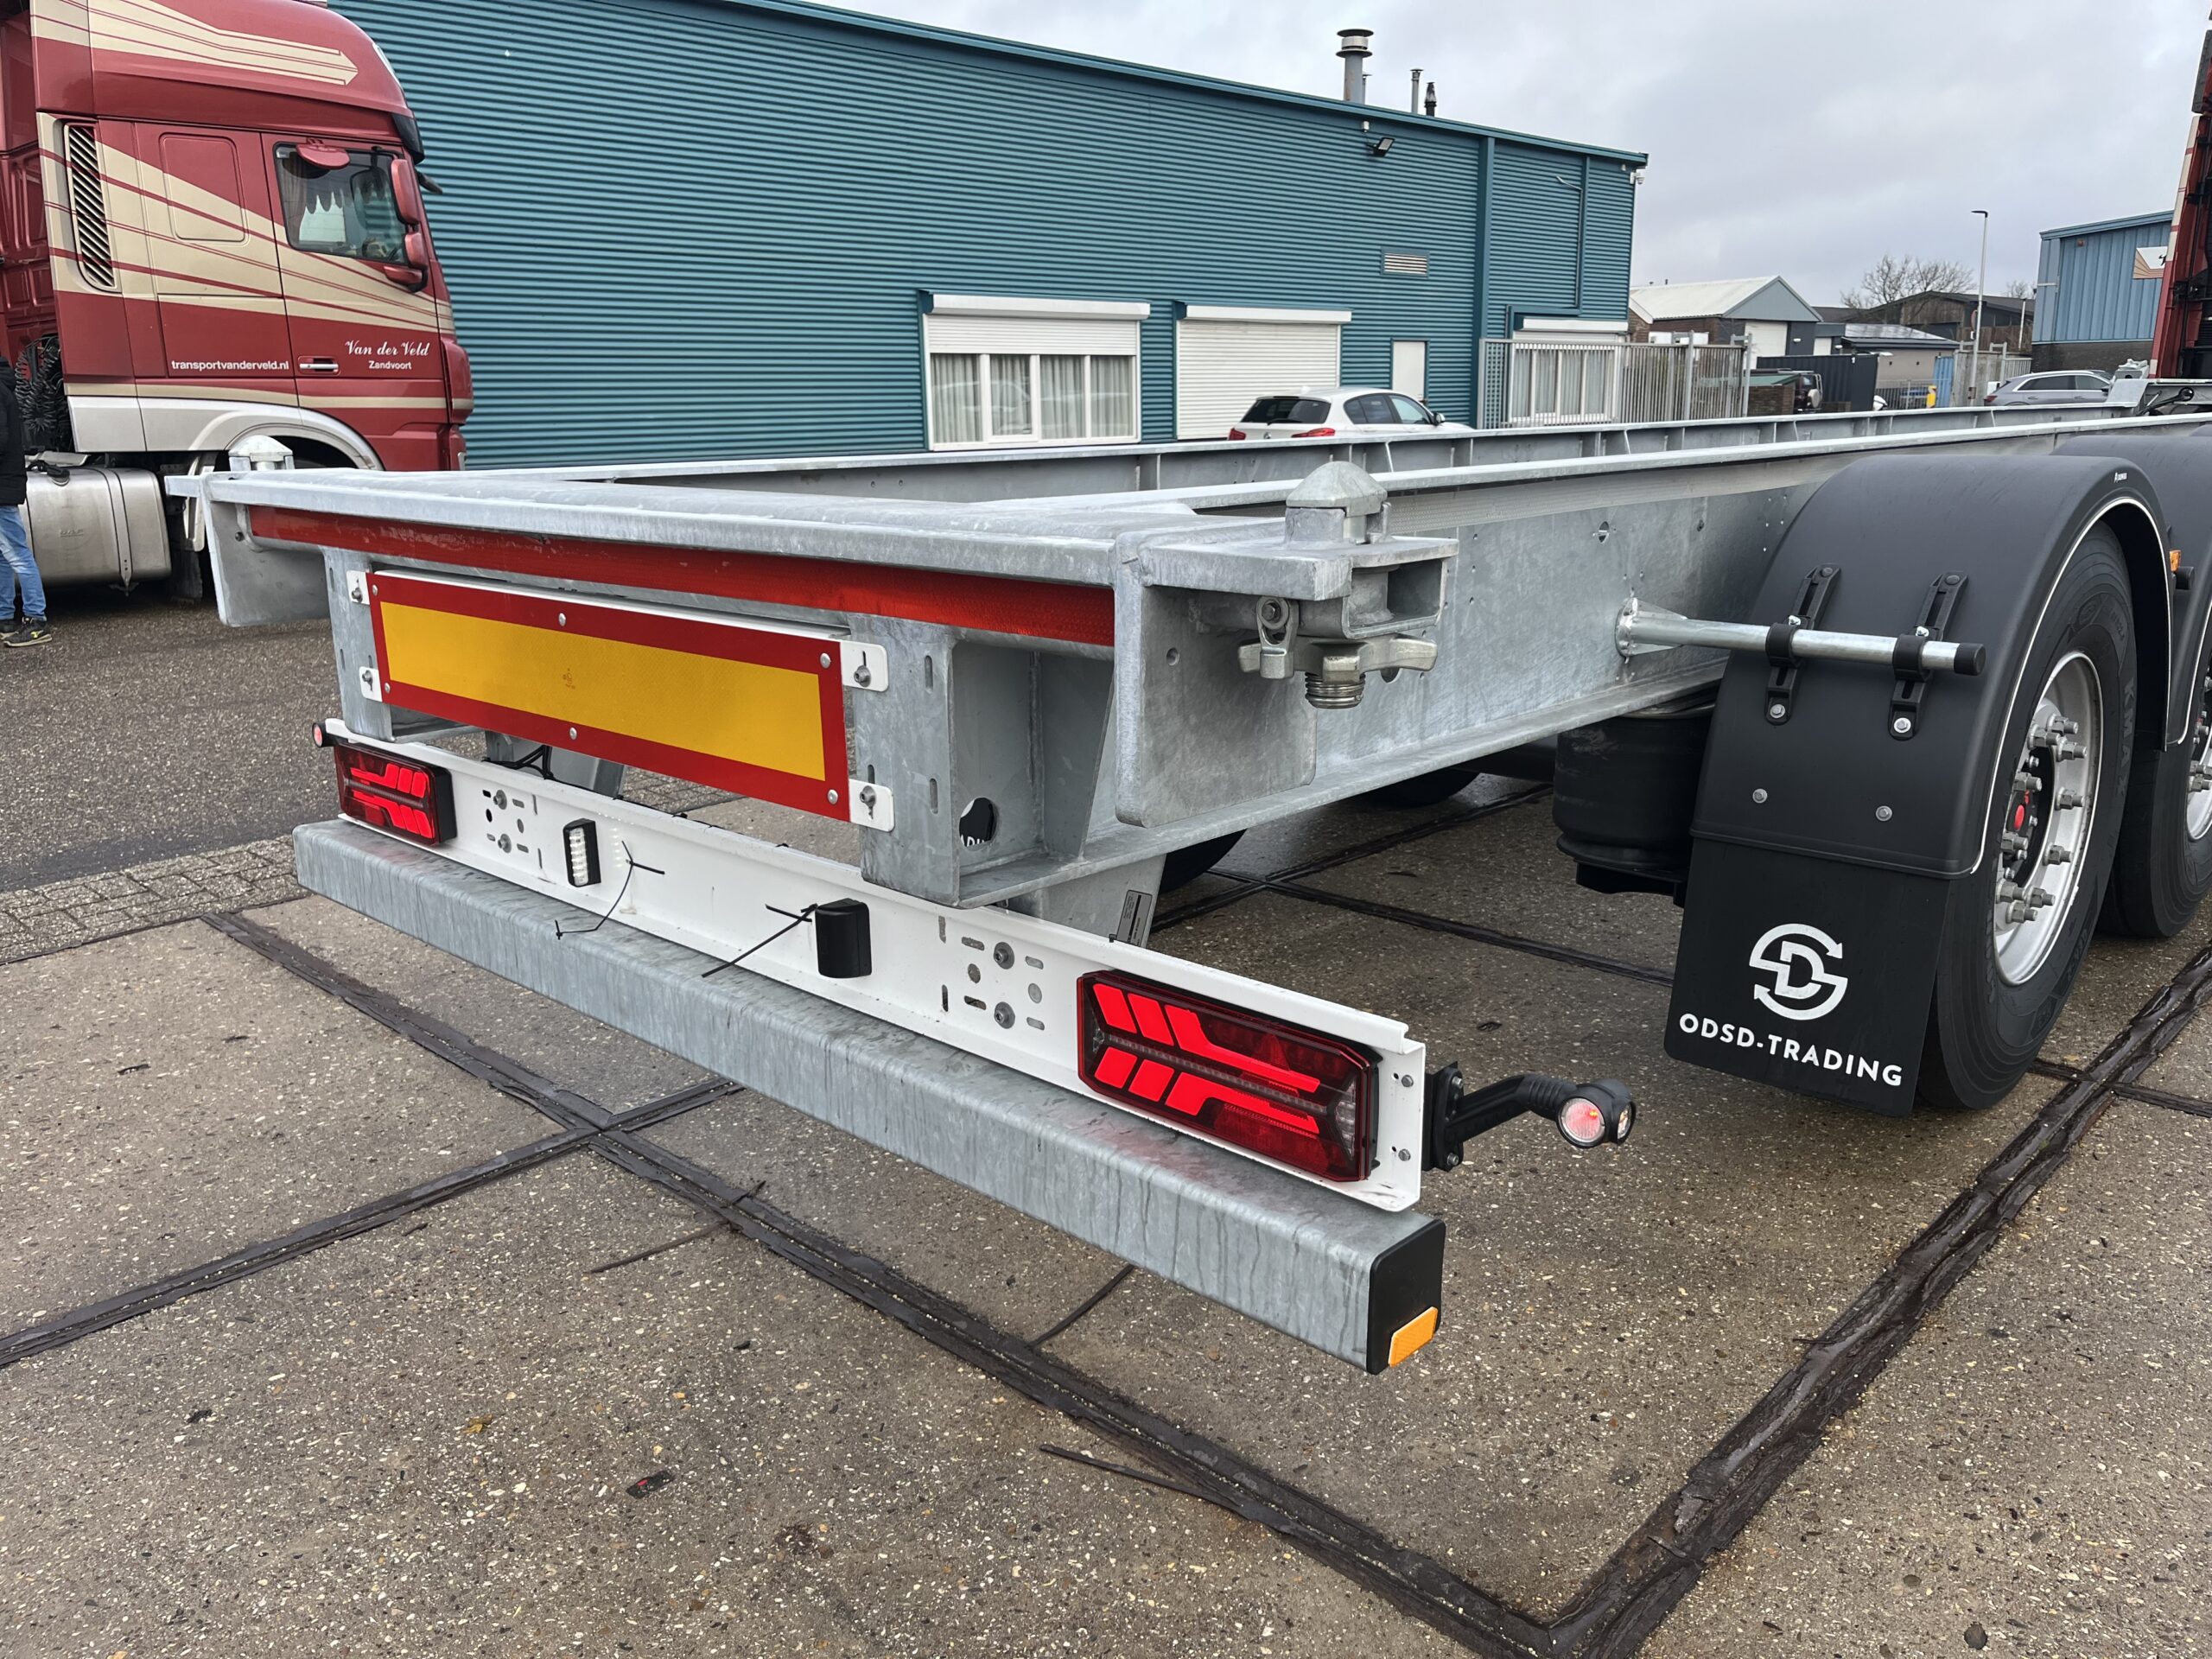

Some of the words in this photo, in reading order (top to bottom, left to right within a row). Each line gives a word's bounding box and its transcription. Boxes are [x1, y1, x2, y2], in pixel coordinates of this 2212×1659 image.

[345, 340, 372, 355] Van
[377, 341, 398, 355] der
[401, 341, 430, 356] Veld
[171, 359, 289, 372] transportvanderveld.nl
[368, 360, 412, 370] Zandvoort
[1679, 1013, 1903, 1086] ODSD-TRADING
